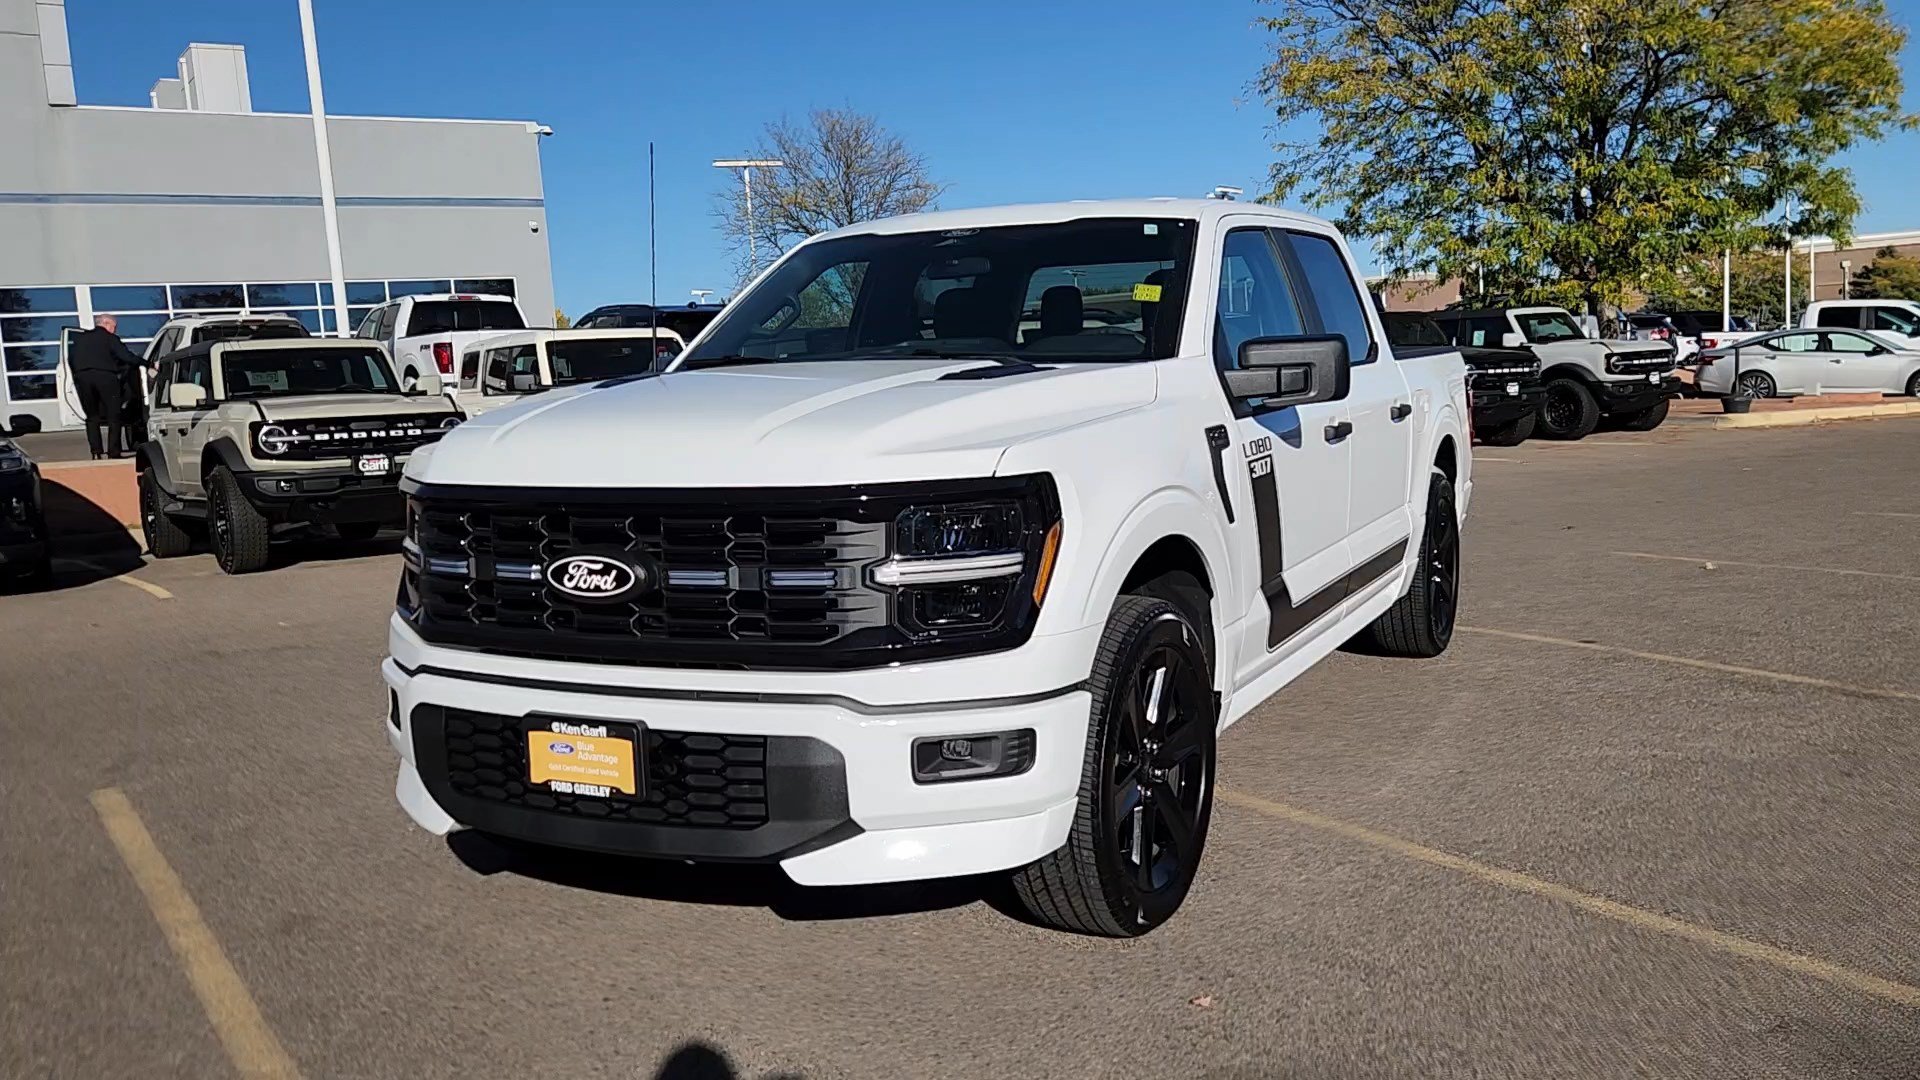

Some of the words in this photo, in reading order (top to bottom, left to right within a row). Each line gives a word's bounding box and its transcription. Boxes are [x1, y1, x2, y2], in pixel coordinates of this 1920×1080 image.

[314, 429, 422, 440] BRONCO
[1242, 436, 1272, 458] LOBO
[359, 458, 389, 471] Garff
[1250, 457, 1271, 479] 307
[563, 561, 617, 590] Ford
[560, 724, 580, 736] Ken
[581, 724, 607, 738] Garff
[577, 741, 595, 752] Blue
[577, 752, 618, 765] Advantage
[551, 781, 573, 793] FORD
[574, 783, 610, 798] GREELEY
